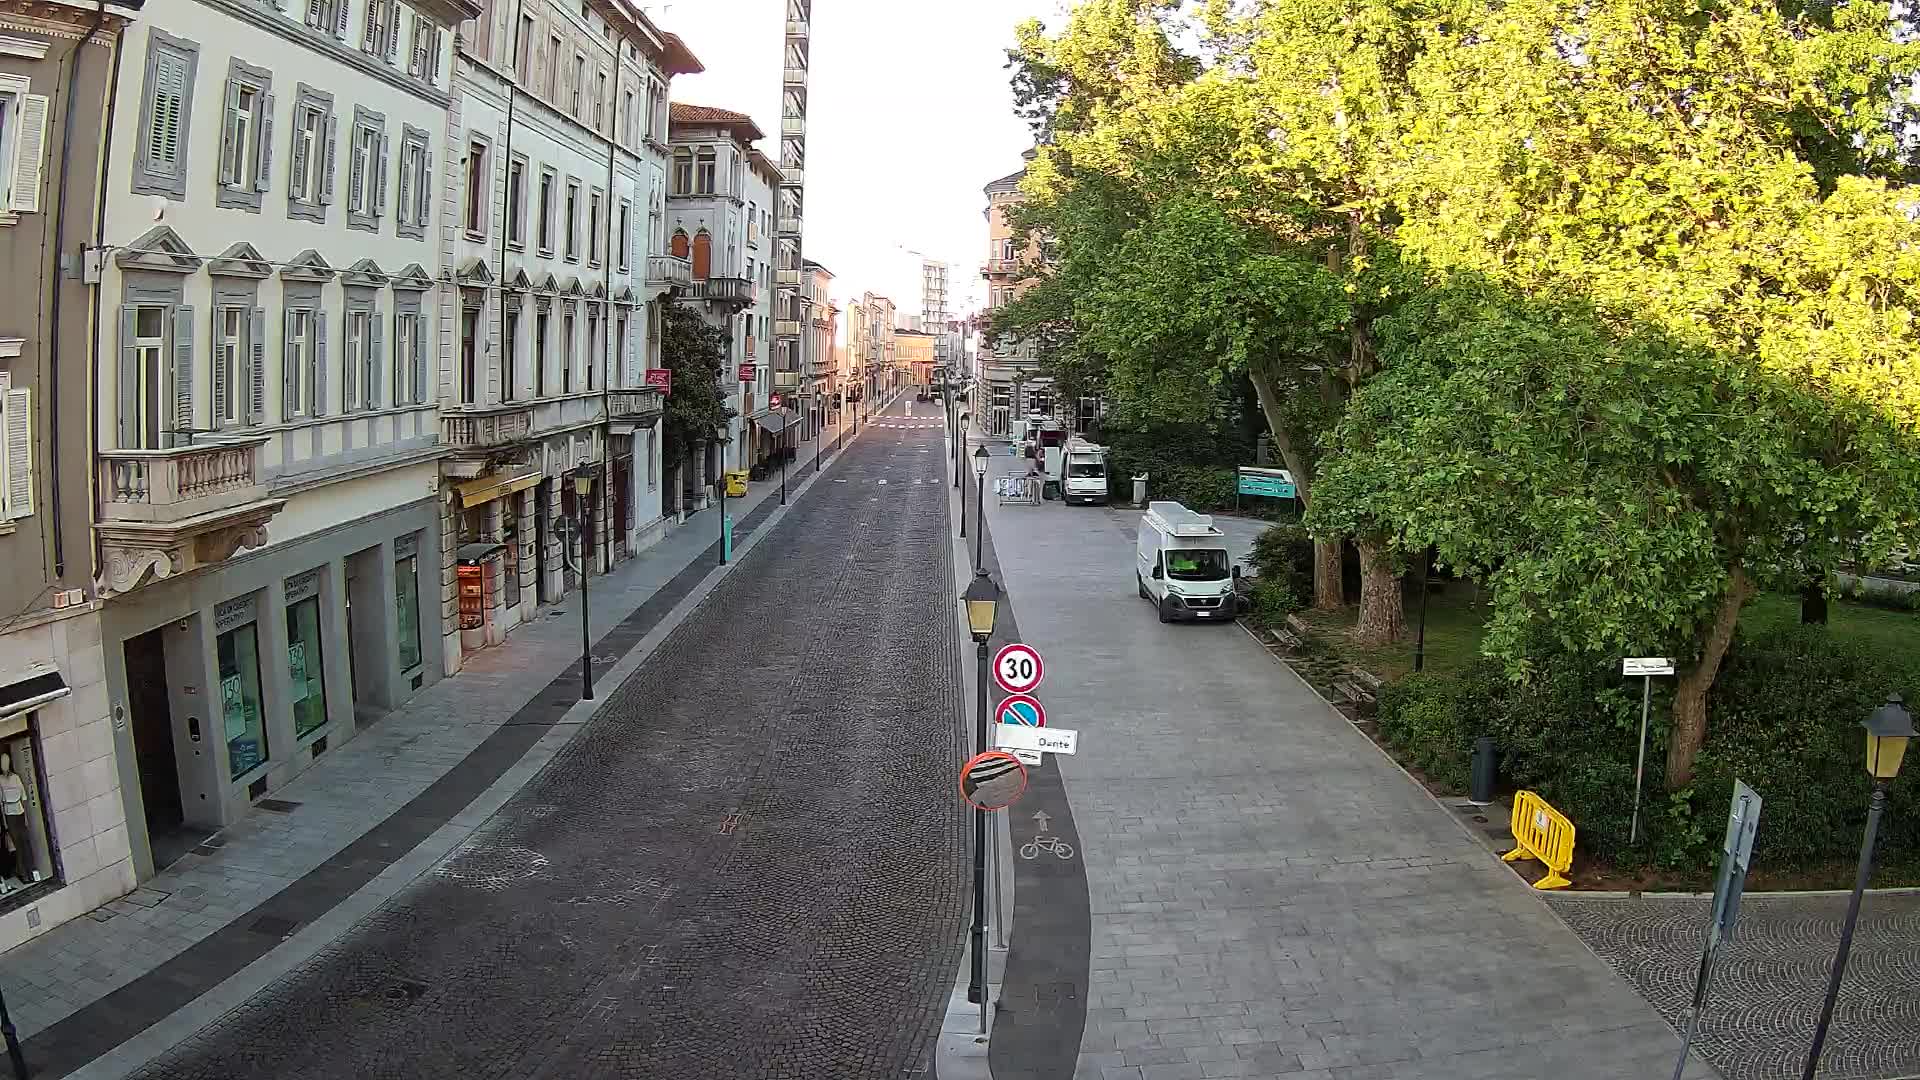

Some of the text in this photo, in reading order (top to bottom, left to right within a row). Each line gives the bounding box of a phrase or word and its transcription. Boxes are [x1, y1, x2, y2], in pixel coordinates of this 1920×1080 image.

[288, 645, 304, 665] 130
[1005, 658, 1032, 679] 30
[222, 677, 241, 700] 130
[1038, 737, 1070, 749] Dante
